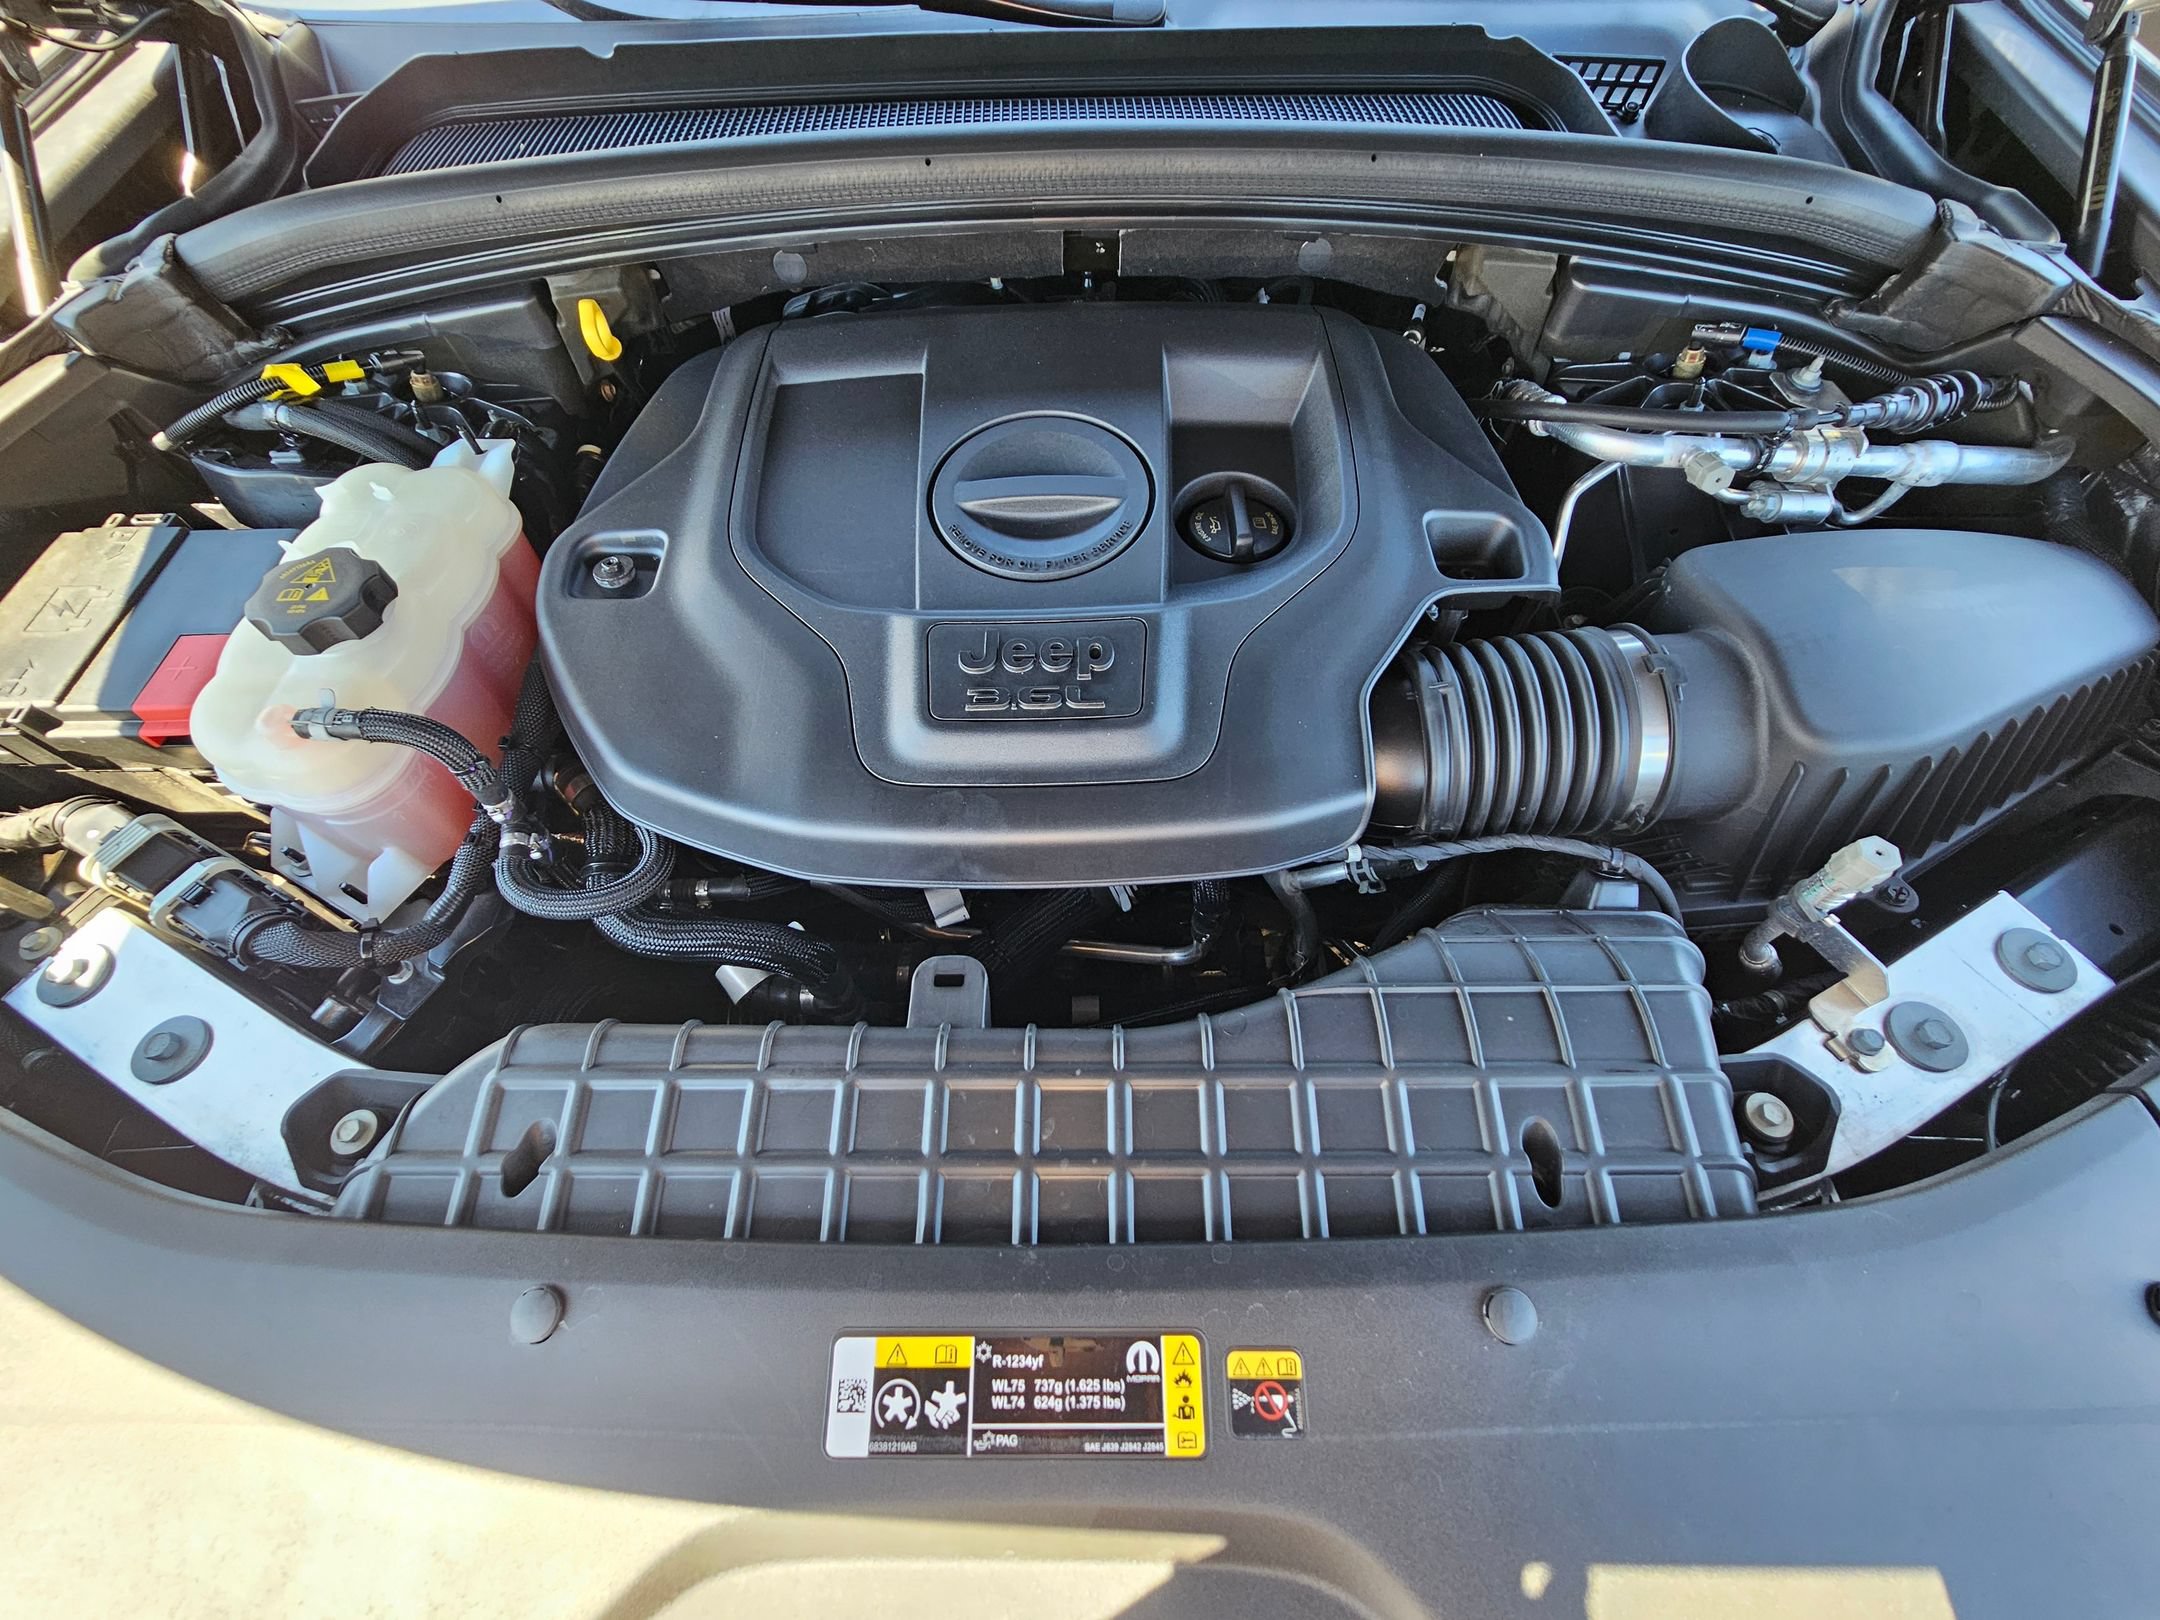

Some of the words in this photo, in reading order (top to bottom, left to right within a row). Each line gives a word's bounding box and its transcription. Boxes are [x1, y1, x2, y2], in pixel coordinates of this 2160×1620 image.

[948, 524, 987, 558] REMOVE
[989, 553, 1014, 567] FOR
[1018, 560, 1040, 571] OIL
[1044, 552, 1089, 570] FILTER
[1091, 520, 1133, 557] SERVICE
[958, 628, 1115, 681] Jeep
[965, 685, 1106, 712] 3.6L
[992, 1354, 1044, 1371] R-1234yf
[991, 1378, 1026, 1393] WL75
[1034, 1378, 1063, 1395] 737g
[1065, 1378, 1101, 1395] (1.625
[1103, 1377, 1126, 1395] lbs)
[991, 1395, 1026, 1410] WL74
[1033, 1395, 1063, 1412] 624g
[1065, 1395, 1101, 1412] (1.375
[1103, 1395, 1126, 1412] lbs)
[996, 1433, 1018, 1448] PAG
[1084, 1442, 1101, 1453] SAE
